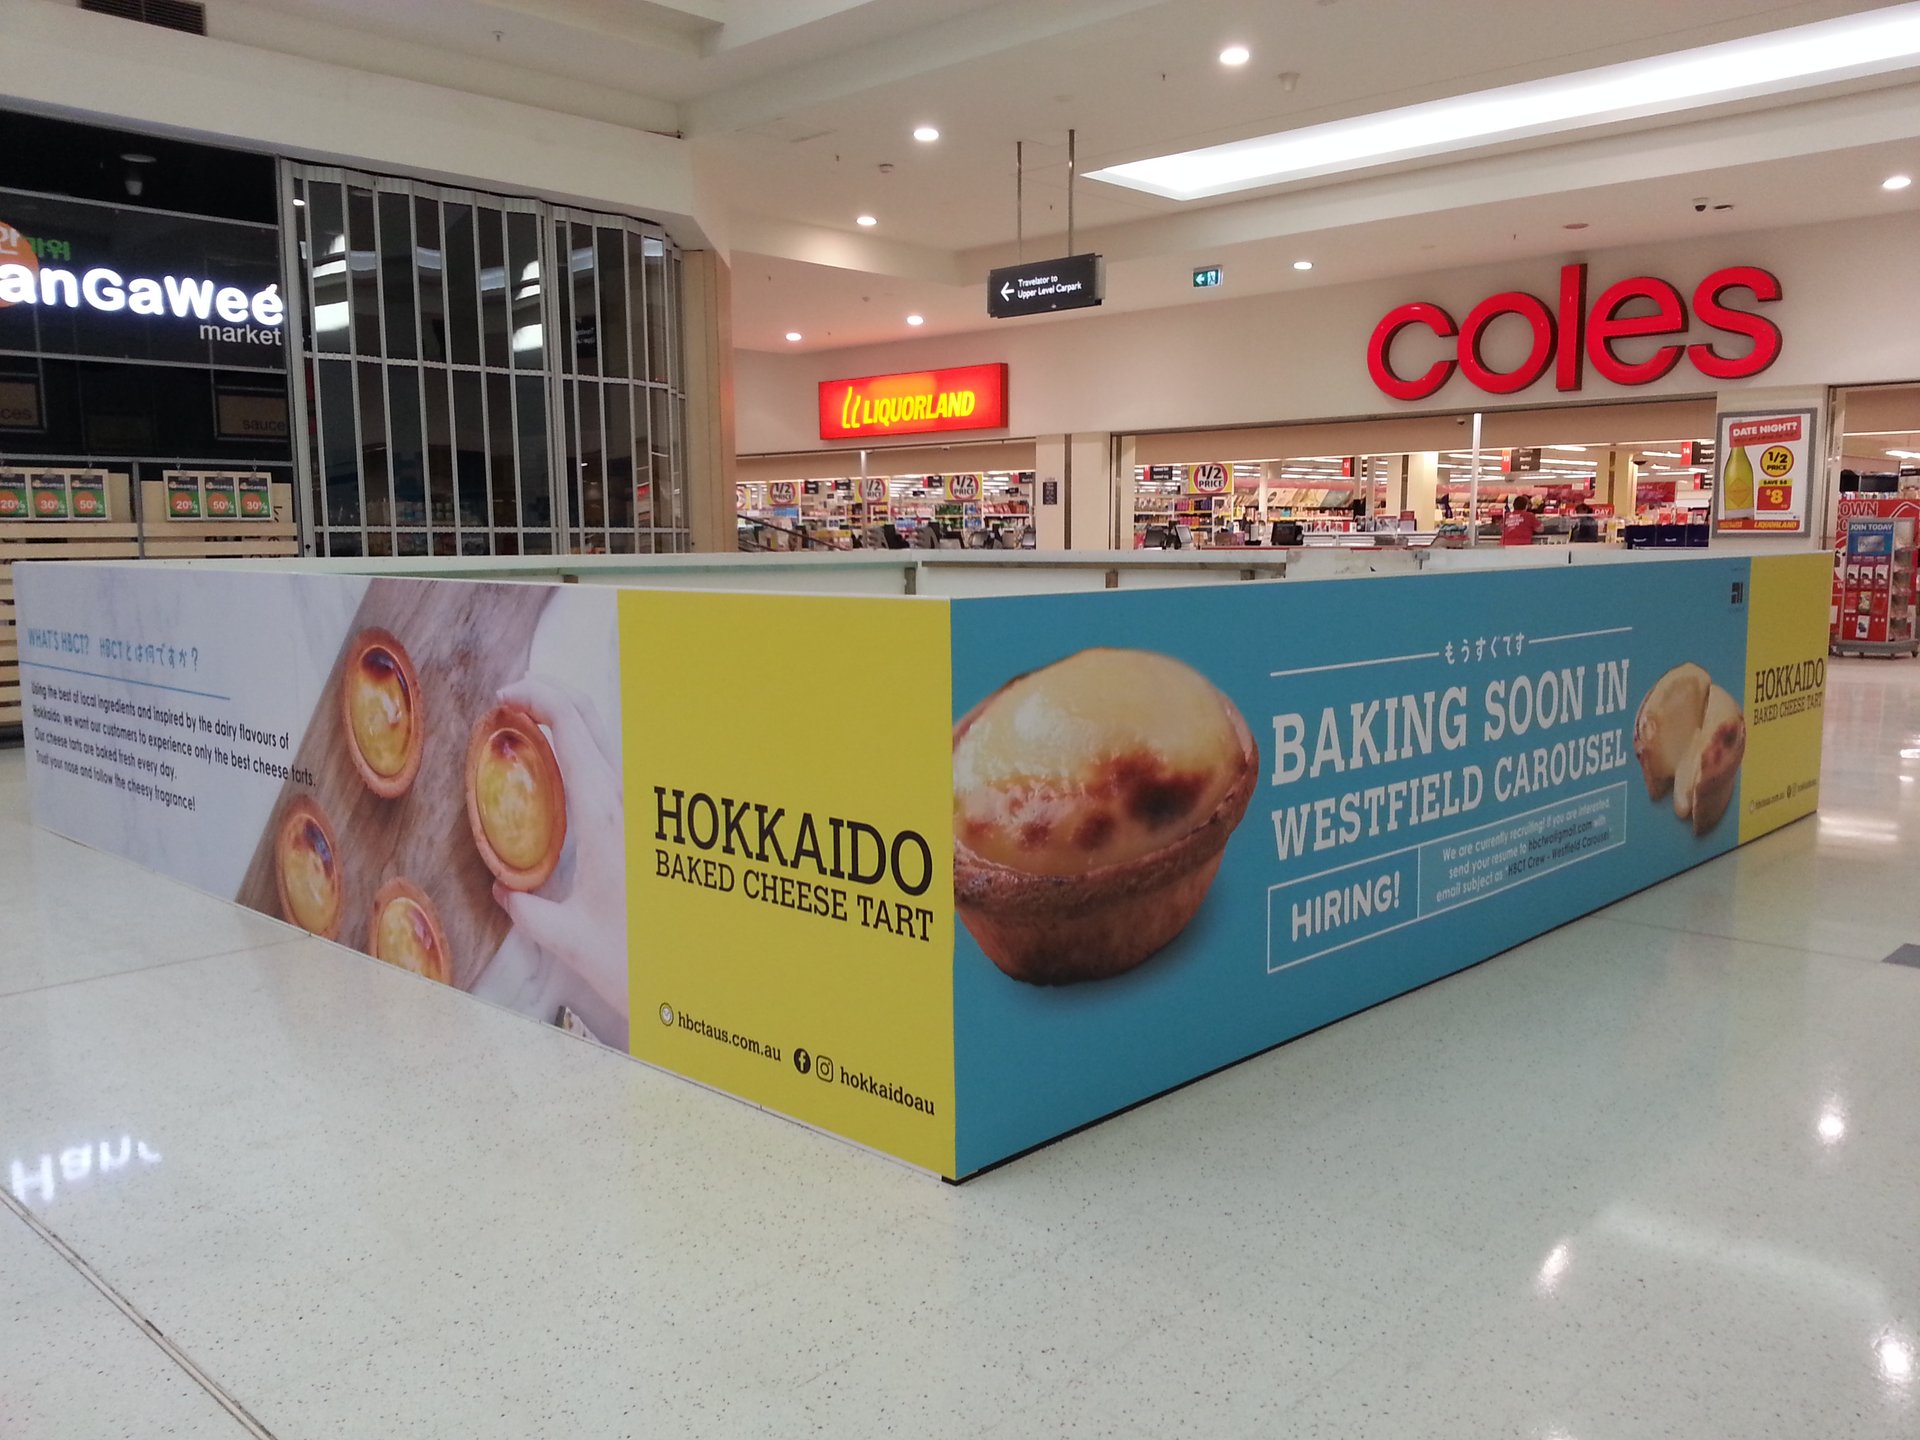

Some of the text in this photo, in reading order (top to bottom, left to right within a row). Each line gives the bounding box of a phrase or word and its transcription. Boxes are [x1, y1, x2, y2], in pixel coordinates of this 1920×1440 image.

[1017, 275, 1058, 287] Travelator to
[1017, 280, 1082, 300] Upper Level Carpark
[199, 323, 282, 346] market
[1367, 264, 1783, 401] coles
[863, 390, 976, 427] LIQUORLAND
[1732, 427, 1758, 437] DATE
[1760, 422, 1798, 434] NIGHT?
[1200, 465, 1222, 480] 1/2
[1767, 451, 1788, 463] 1/2
[774, 482, 791, 494] 1/2
[954, 475, 974, 488] 1/2
[1198, 480, 1223, 488] PRICE
[1868, 523, 1893, 531] TODAY
[1754, 657, 1825, 704] HOKKAIDO
[137, 704, 152, 719] and
[153, 705, 184, 727] inspired
[185, 711, 197, 734] by
[199, 714, 213, 733] the
[214, 718, 238, 742] dairy
[239, 722, 277, 748] flavours
[279, 732, 289, 750] of
[1271, 658, 1630, 787] BAKING SOON IN
[1753, 691, 1824, 726] BAKED CHEESE TART
[83, 743, 94, 756] are
[95, 743, 117, 762] baked
[118, 748, 136, 767] fresh
[137, 757, 158, 777] every
[160, 761, 177, 782] day.
[102, 722, 138, 743] customers
[138, 728, 147, 745] to
[148, 734, 192, 757] experience
[194, 743, 213, 764] only
[214, 746, 229, 766] the
[230, 749, 250, 771] best
[253, 757, 289, 780] cheese
[291, 764, 316, 788] tarts.
[114, 772, 126, 790] the
[127, 778, 153, 799] cheesy
[154, 784, 196, 812] fragrance!
[1271, 729, 1627, 861] WESTFIELD CAROUSEL
[654, 786, 933, 896] HOKKAIDO
[1442, 847, 1456, 862] We
[1459, 843, 1473, 857] are
[1475, 830, 1509, 852] currently
[1436, 882, 1462, 902] email
[1463, 872, 1493, 893] subject
[1494, 870, 1503, 882] as
[1527, 854, 1546, 870] Crew
[1448, 860, 1470, 879] send
[1471, 856, 1491, 874] your
[1491, 848, 1518, 864] resume
[1519, 842, 1528, 855] to
[655, 849, 934, 942] BAKED CHEESE TART
[1291, 871, 1401, 942] HIRING!
[678, 1011, 936, 1116] hbctaus.com.au hokkaidoau
